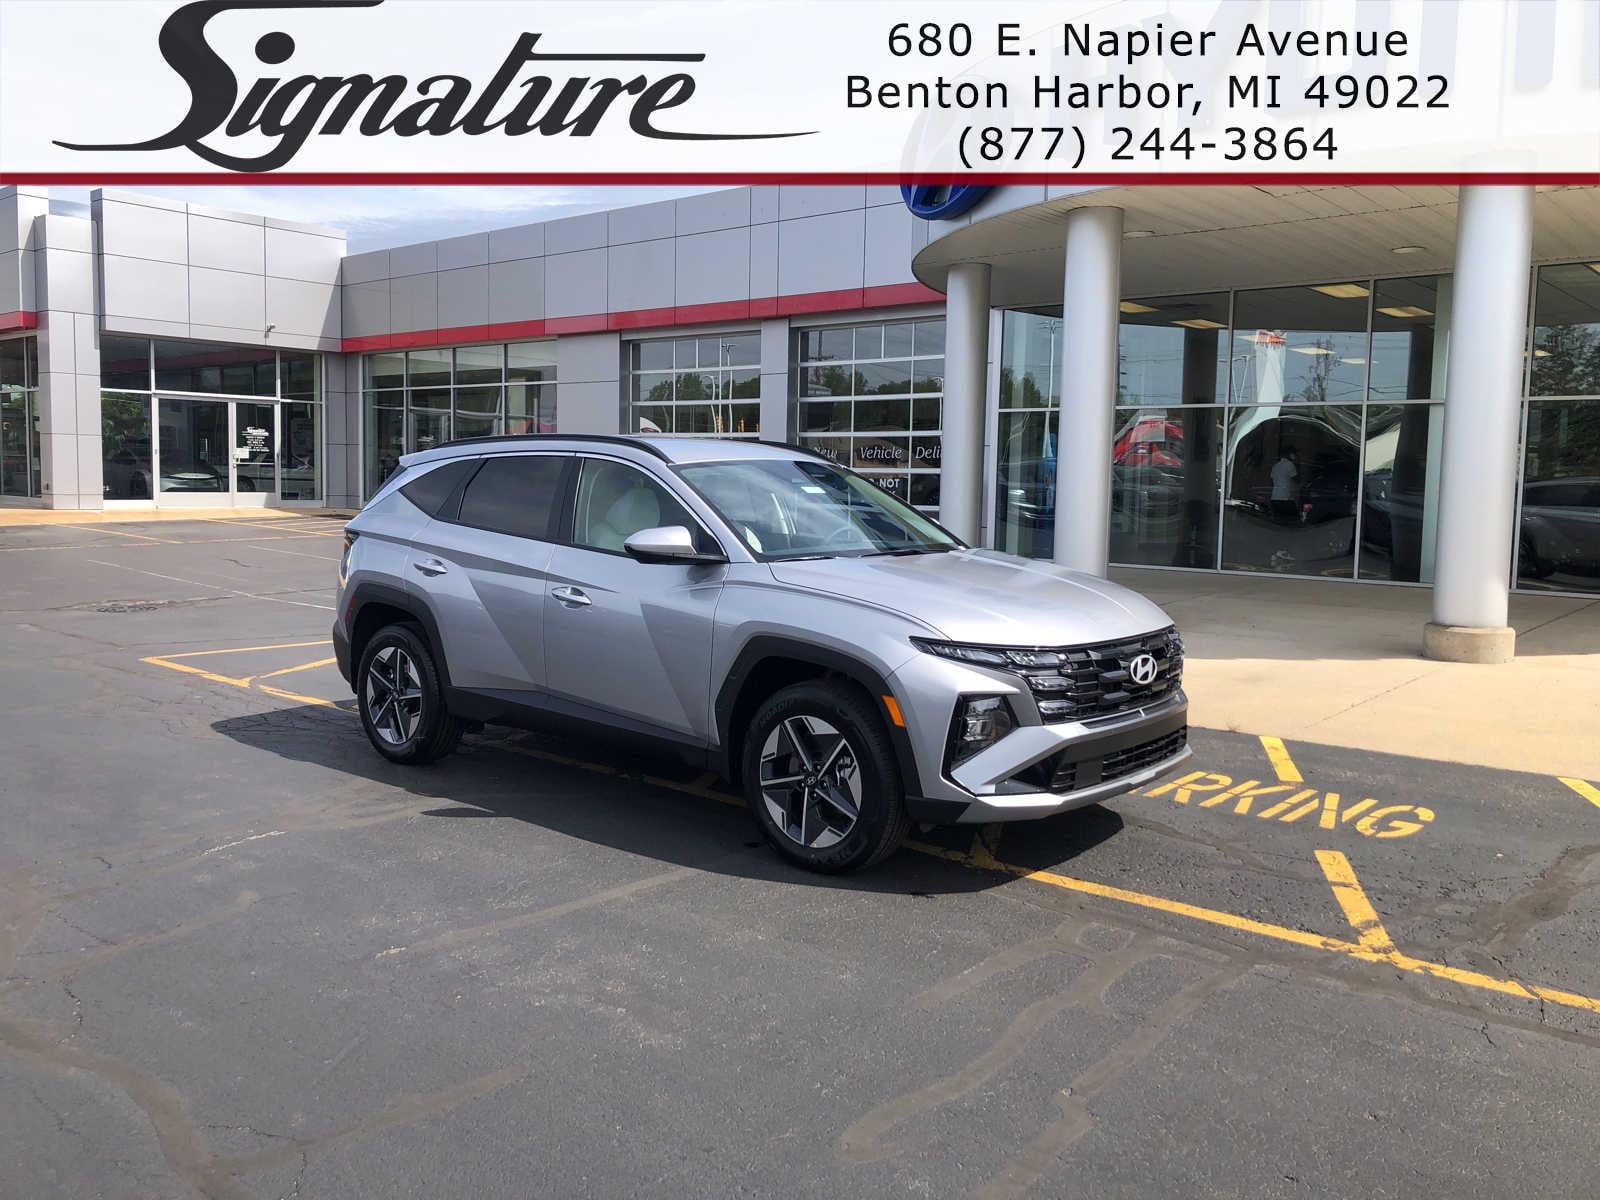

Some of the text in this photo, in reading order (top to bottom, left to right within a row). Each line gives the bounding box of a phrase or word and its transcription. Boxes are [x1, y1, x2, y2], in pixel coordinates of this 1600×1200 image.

[860, 446, 902, 459] Vehicle
[880, 478, 900, 488] NOT
[1129, 771, 1436, 838] RKING
